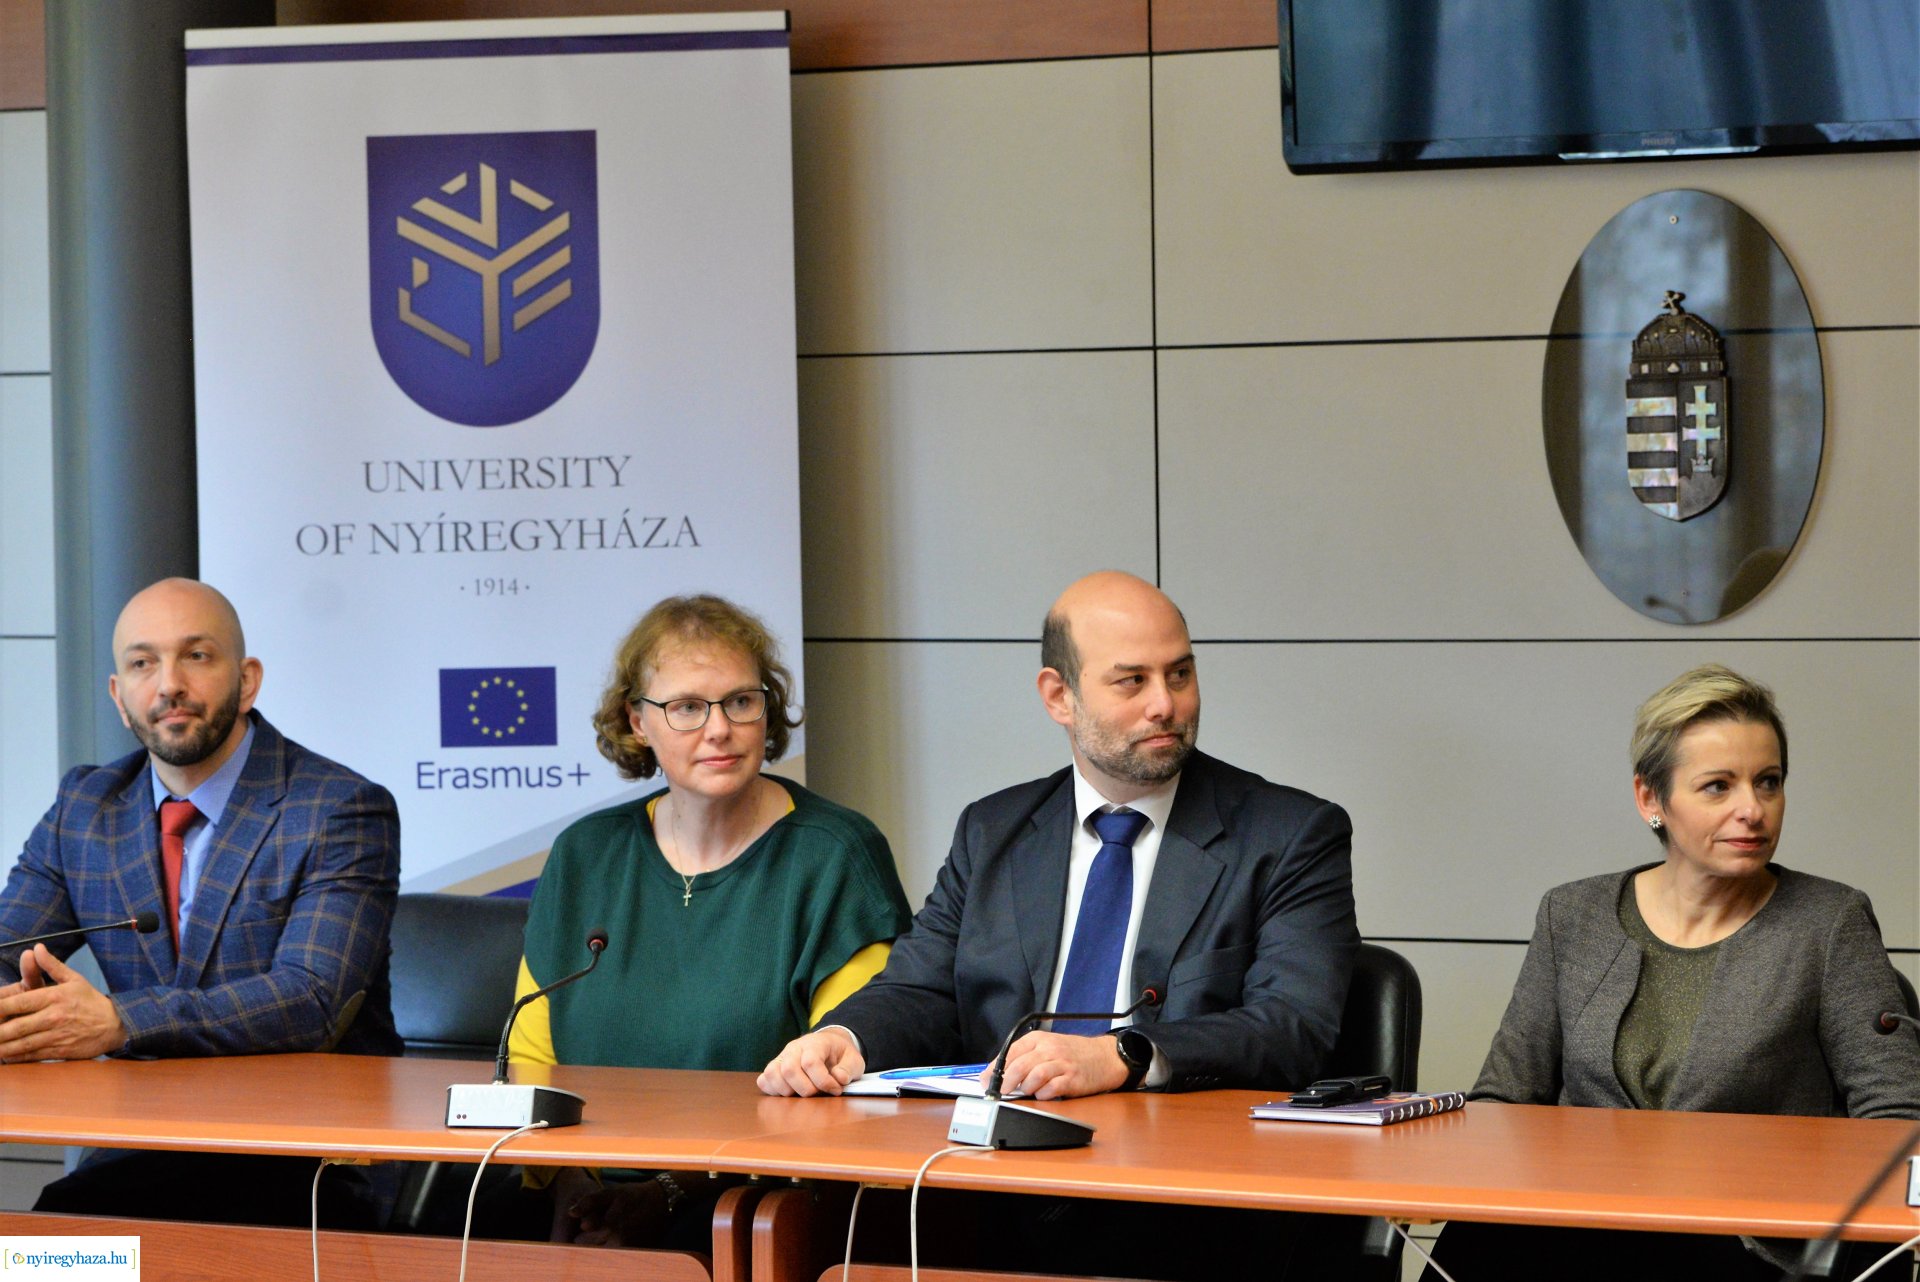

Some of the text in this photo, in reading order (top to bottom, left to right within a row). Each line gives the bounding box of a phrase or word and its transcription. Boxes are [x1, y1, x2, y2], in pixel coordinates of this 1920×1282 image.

[363, 456, 631, 493] UNIVERSITY
[296, 509, 700, 555] OF NYÍREGYHÁZA
[416, 761, 591, 790] Erasmus+
